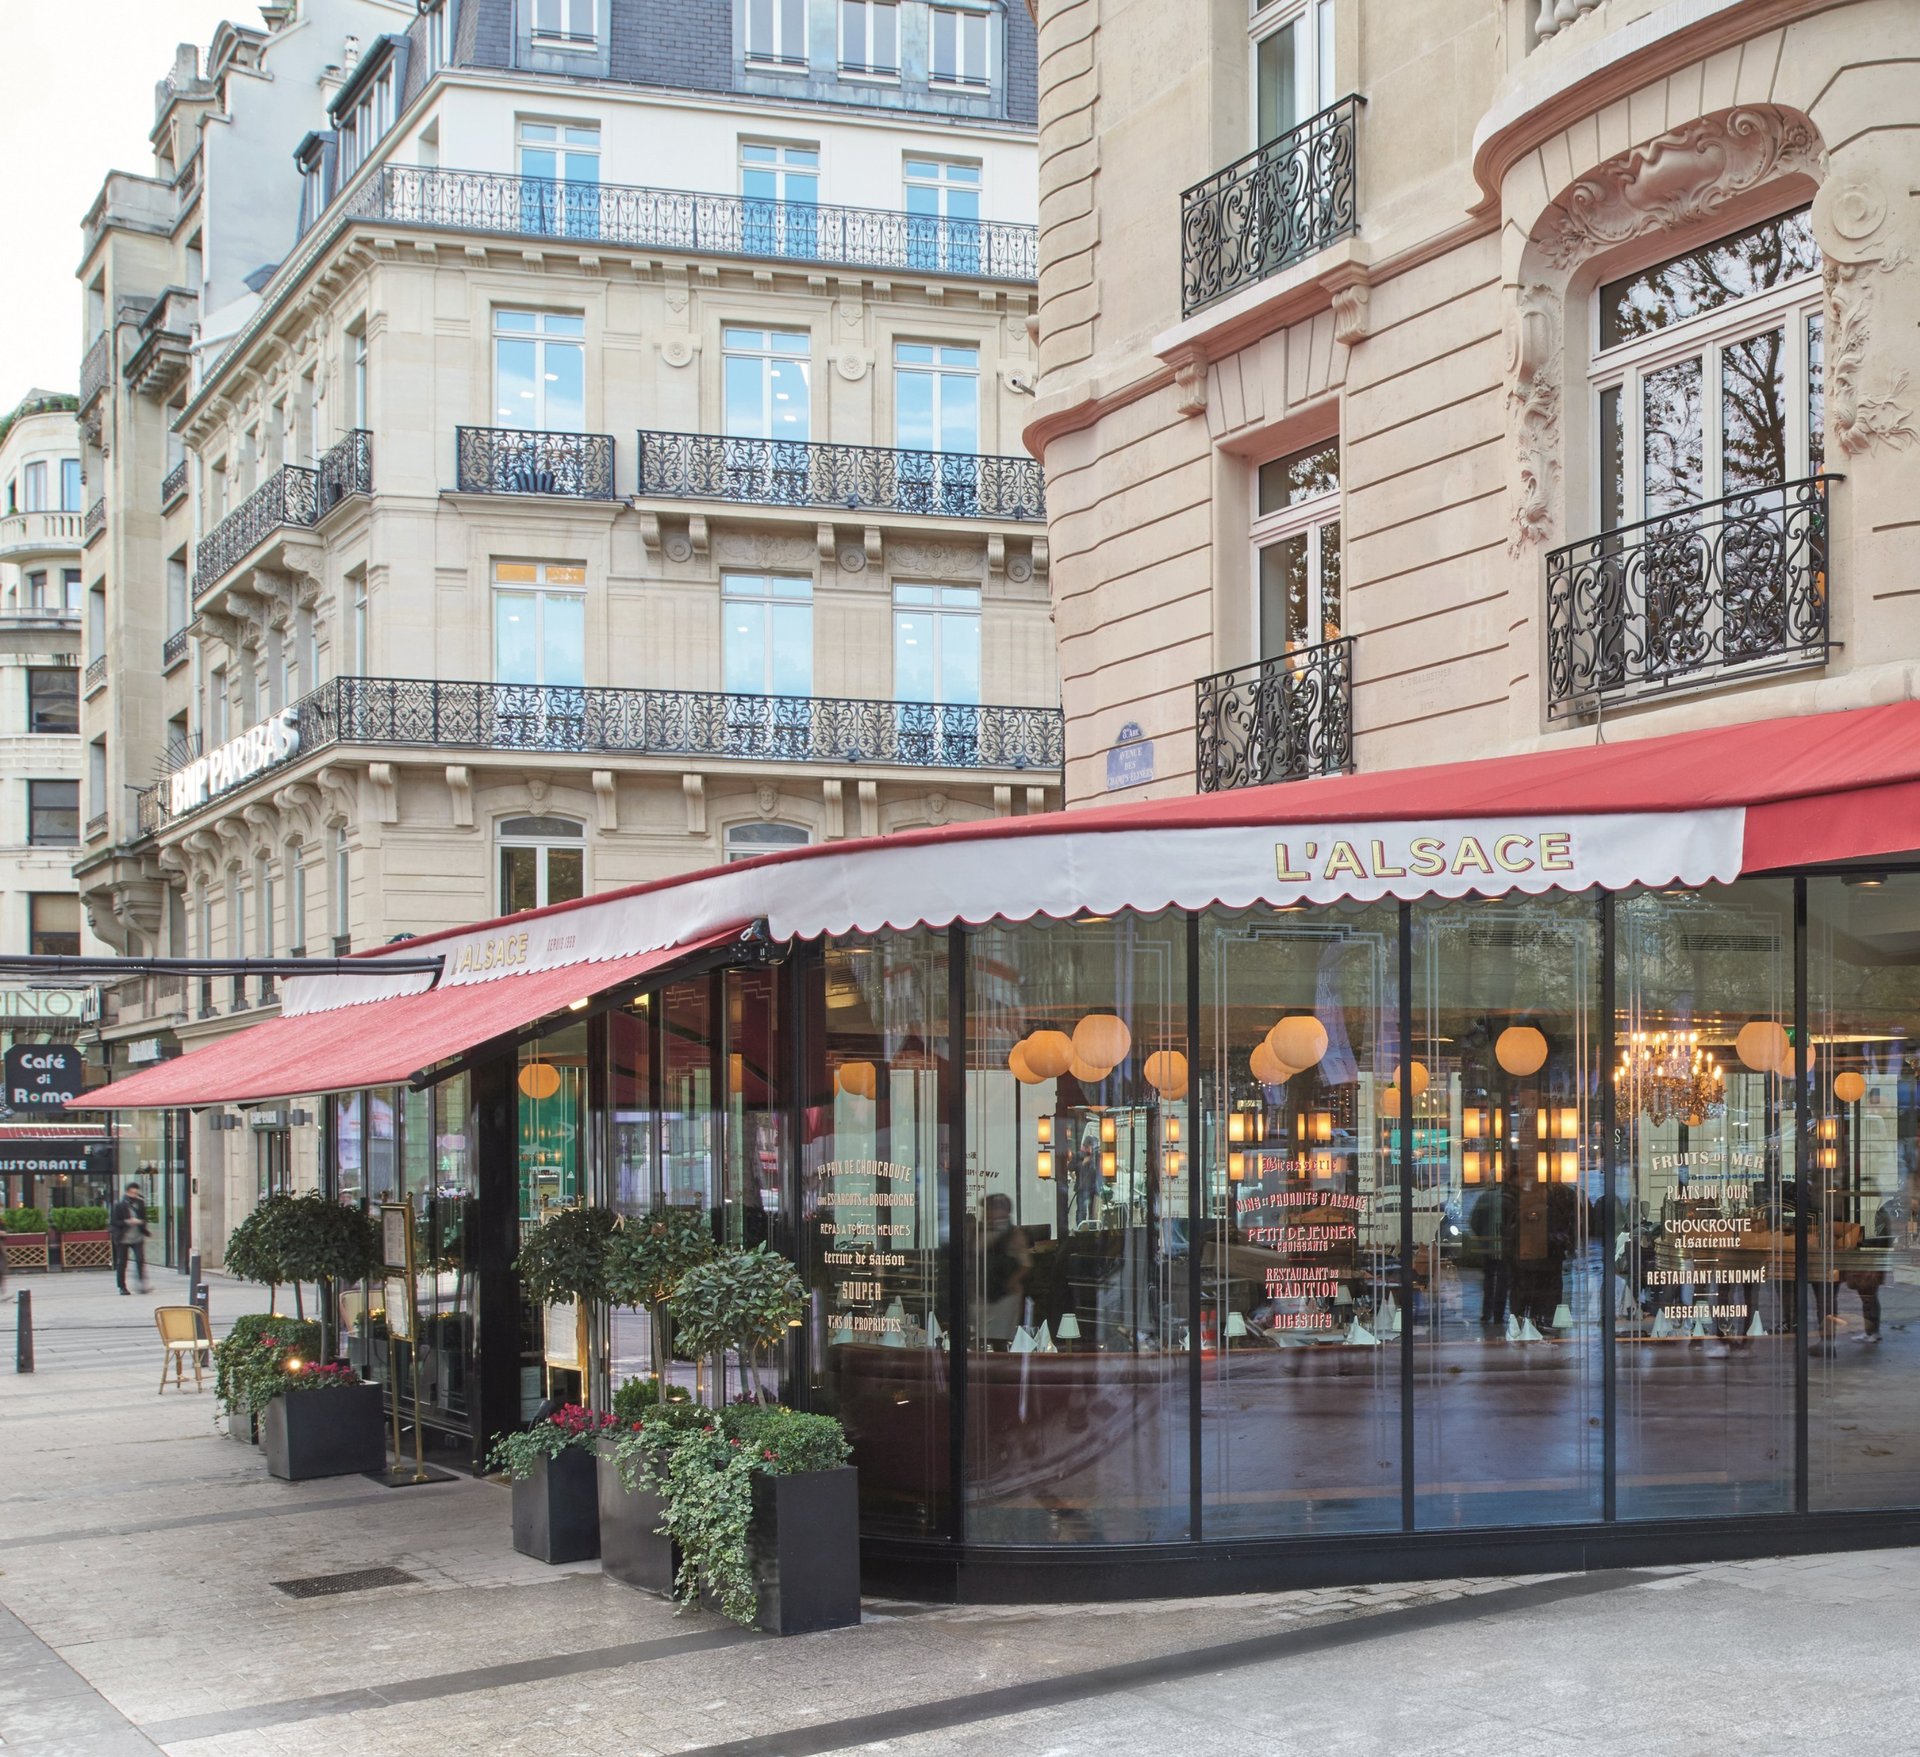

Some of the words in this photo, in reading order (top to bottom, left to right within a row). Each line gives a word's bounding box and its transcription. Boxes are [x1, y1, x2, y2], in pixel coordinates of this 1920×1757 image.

[172, 758, 208, 816] BNP
[209, 707, 300, 795] PARIBAS
[1275, 832, 1574, 881] L'ALSACE
[20, 1054, 65, 1069] Café
[36, 1073, 51, 1084] di
[14, 1088, 73, 1103] Roma
[1261, 1155, 1338, 1173] Brasserie
[1651, 1151, 1709, 1171] FRUITS
[1731, 1152, 1764, 1169] MER
[826, 1161, 843, 1178] PRIX
[844, 1160, 854, 1175] DE
[856, 1160, 912, 1182] CHOUCROUTE
[827, 1192, 862, 1206] ESCARGOTS
[869, 1193, 915, 1207] BOURGOGNE
[1667, 1185, 1700, 1200] PLATS
[1703, 1185, 1718, 1200] DU
[1721, 1184, 1749, 1199] JOUR
[1236, 1196, 1261, 1214] VINS
[1270, 1191, 1318, 1208] PRODUITS
[1320, 1192, 1369, 1212] D'ALSACE
[820, 1223, 840, 1235] REPAS
[847, 1223, 876, 1236] TOUTES
[877, 1224, 911, 1236] HEURES
[1248, 1227, 1284, 1242] PETIT
[1277, 1239, 1329, 1253] CROISSANTS
[1674, 1234, 1741, 1249] alsacienne
[824, 1250, 853, 1265] terrine
[855, 1251, 867, 1265] de
[868, 1251, 905, 1266] saison
[1265, 1267, 1329, 1281] RESTAURANT
[1647, 1270, 1712, 1286] RESTAURANT
[1715, 1266, 1766, 1284] RENOMMÉ
[842, 1281, 881, 1301] SOUPER
[1265, 1281, 1339, 1299] TRADITION
[1664, 1305, 1710, 1319] DESSERTS
[1712, 1304, 1748, 1318] MAISON
[828, 1315, 843, 1329] VINS
[844, 1316, 853, 1329] DE
[854, 1314, 901, 1333] PROPRIÉTÉS
[1274, 1312, 1332, 1329] DIGESTIFS
